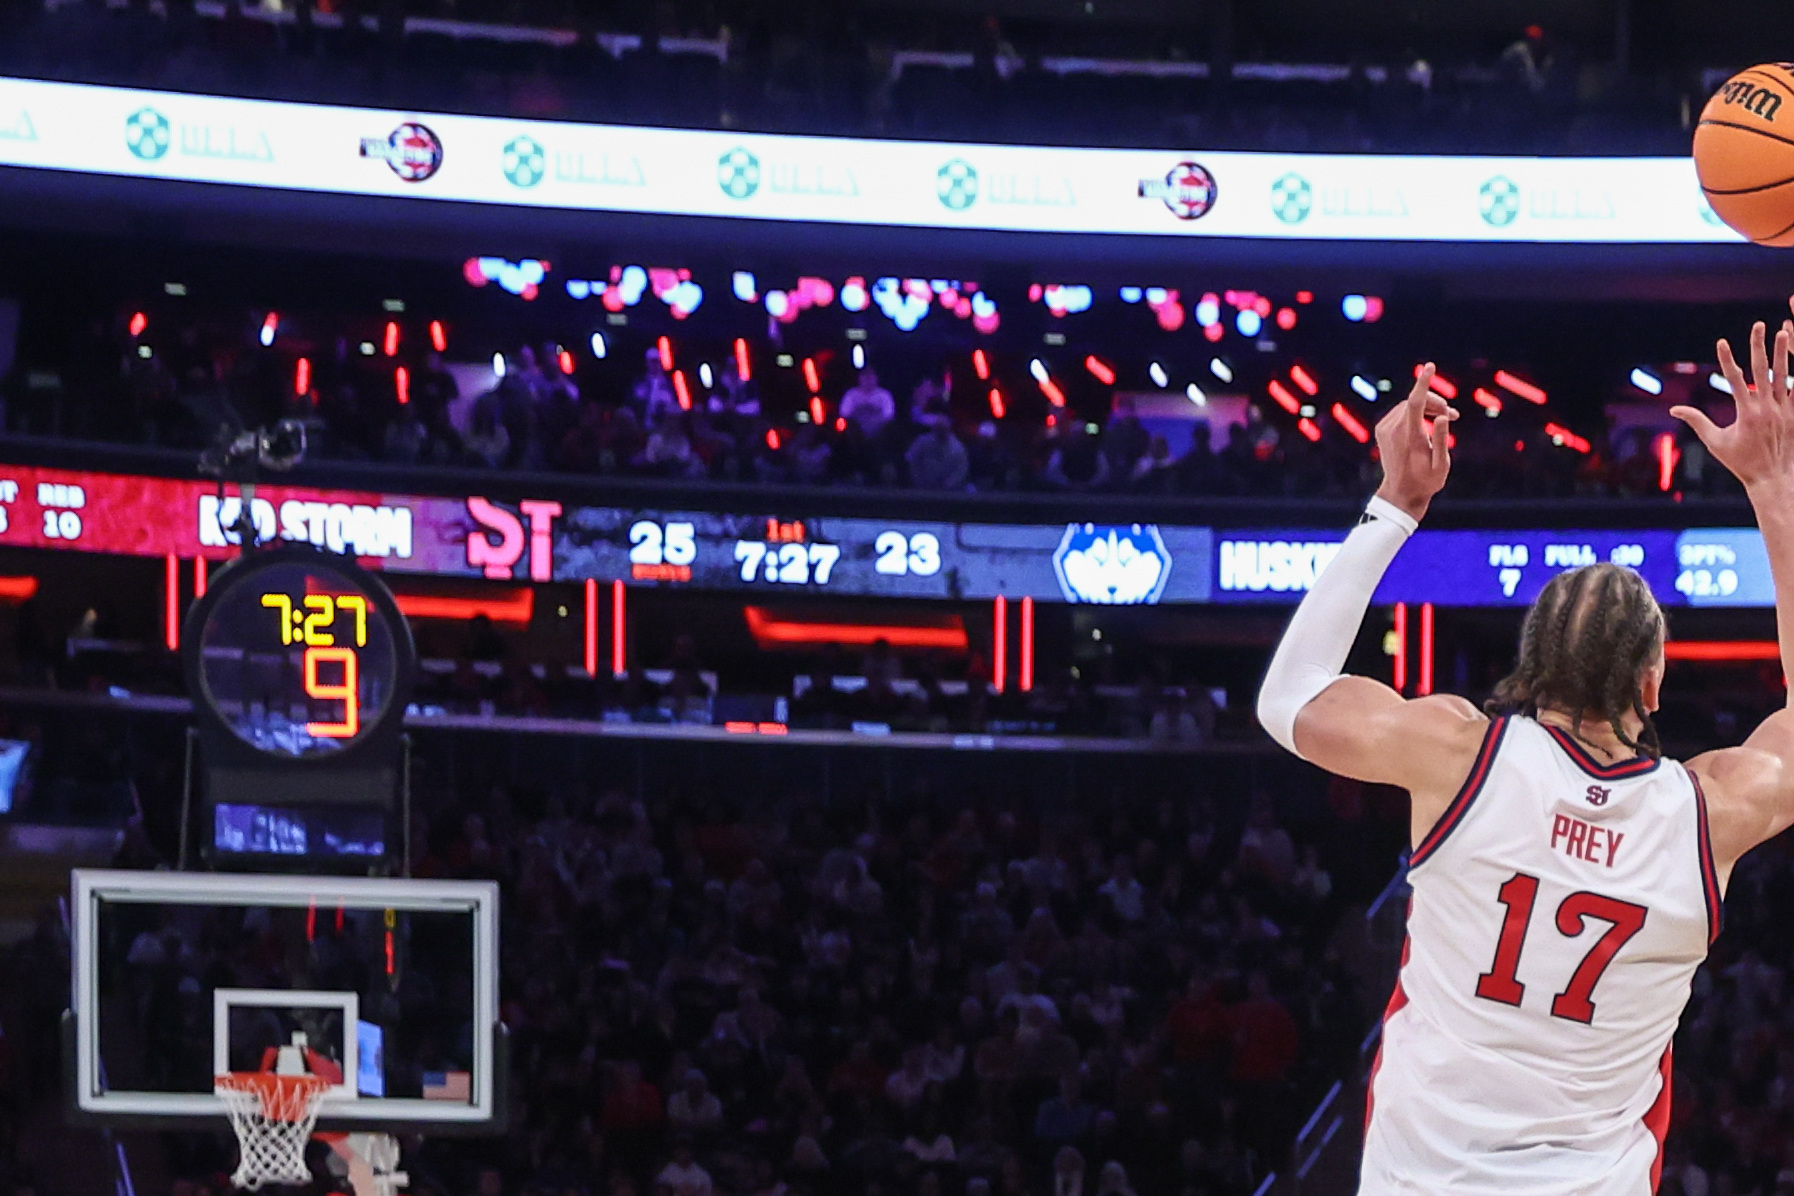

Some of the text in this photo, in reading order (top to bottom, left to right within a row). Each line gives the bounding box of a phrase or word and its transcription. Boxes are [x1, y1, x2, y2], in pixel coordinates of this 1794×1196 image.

[43, 510, 82, 540] 10
[280, 499, 412, 558] STORM
[629, 520, 697, 566] 25
[734, 540, 841, 585] 7:27
[875, 531, 941, 577] 23
[1219, 540, 1344, 592] HUSKI
[1498, 568, 1522, 598] 7
[261, 594, 368, 648] 7:27
[305, 647, 358, 738] 9
[1550, 813, 1625, 868] PREY
[1474, 872, 1649, 1026] 17
